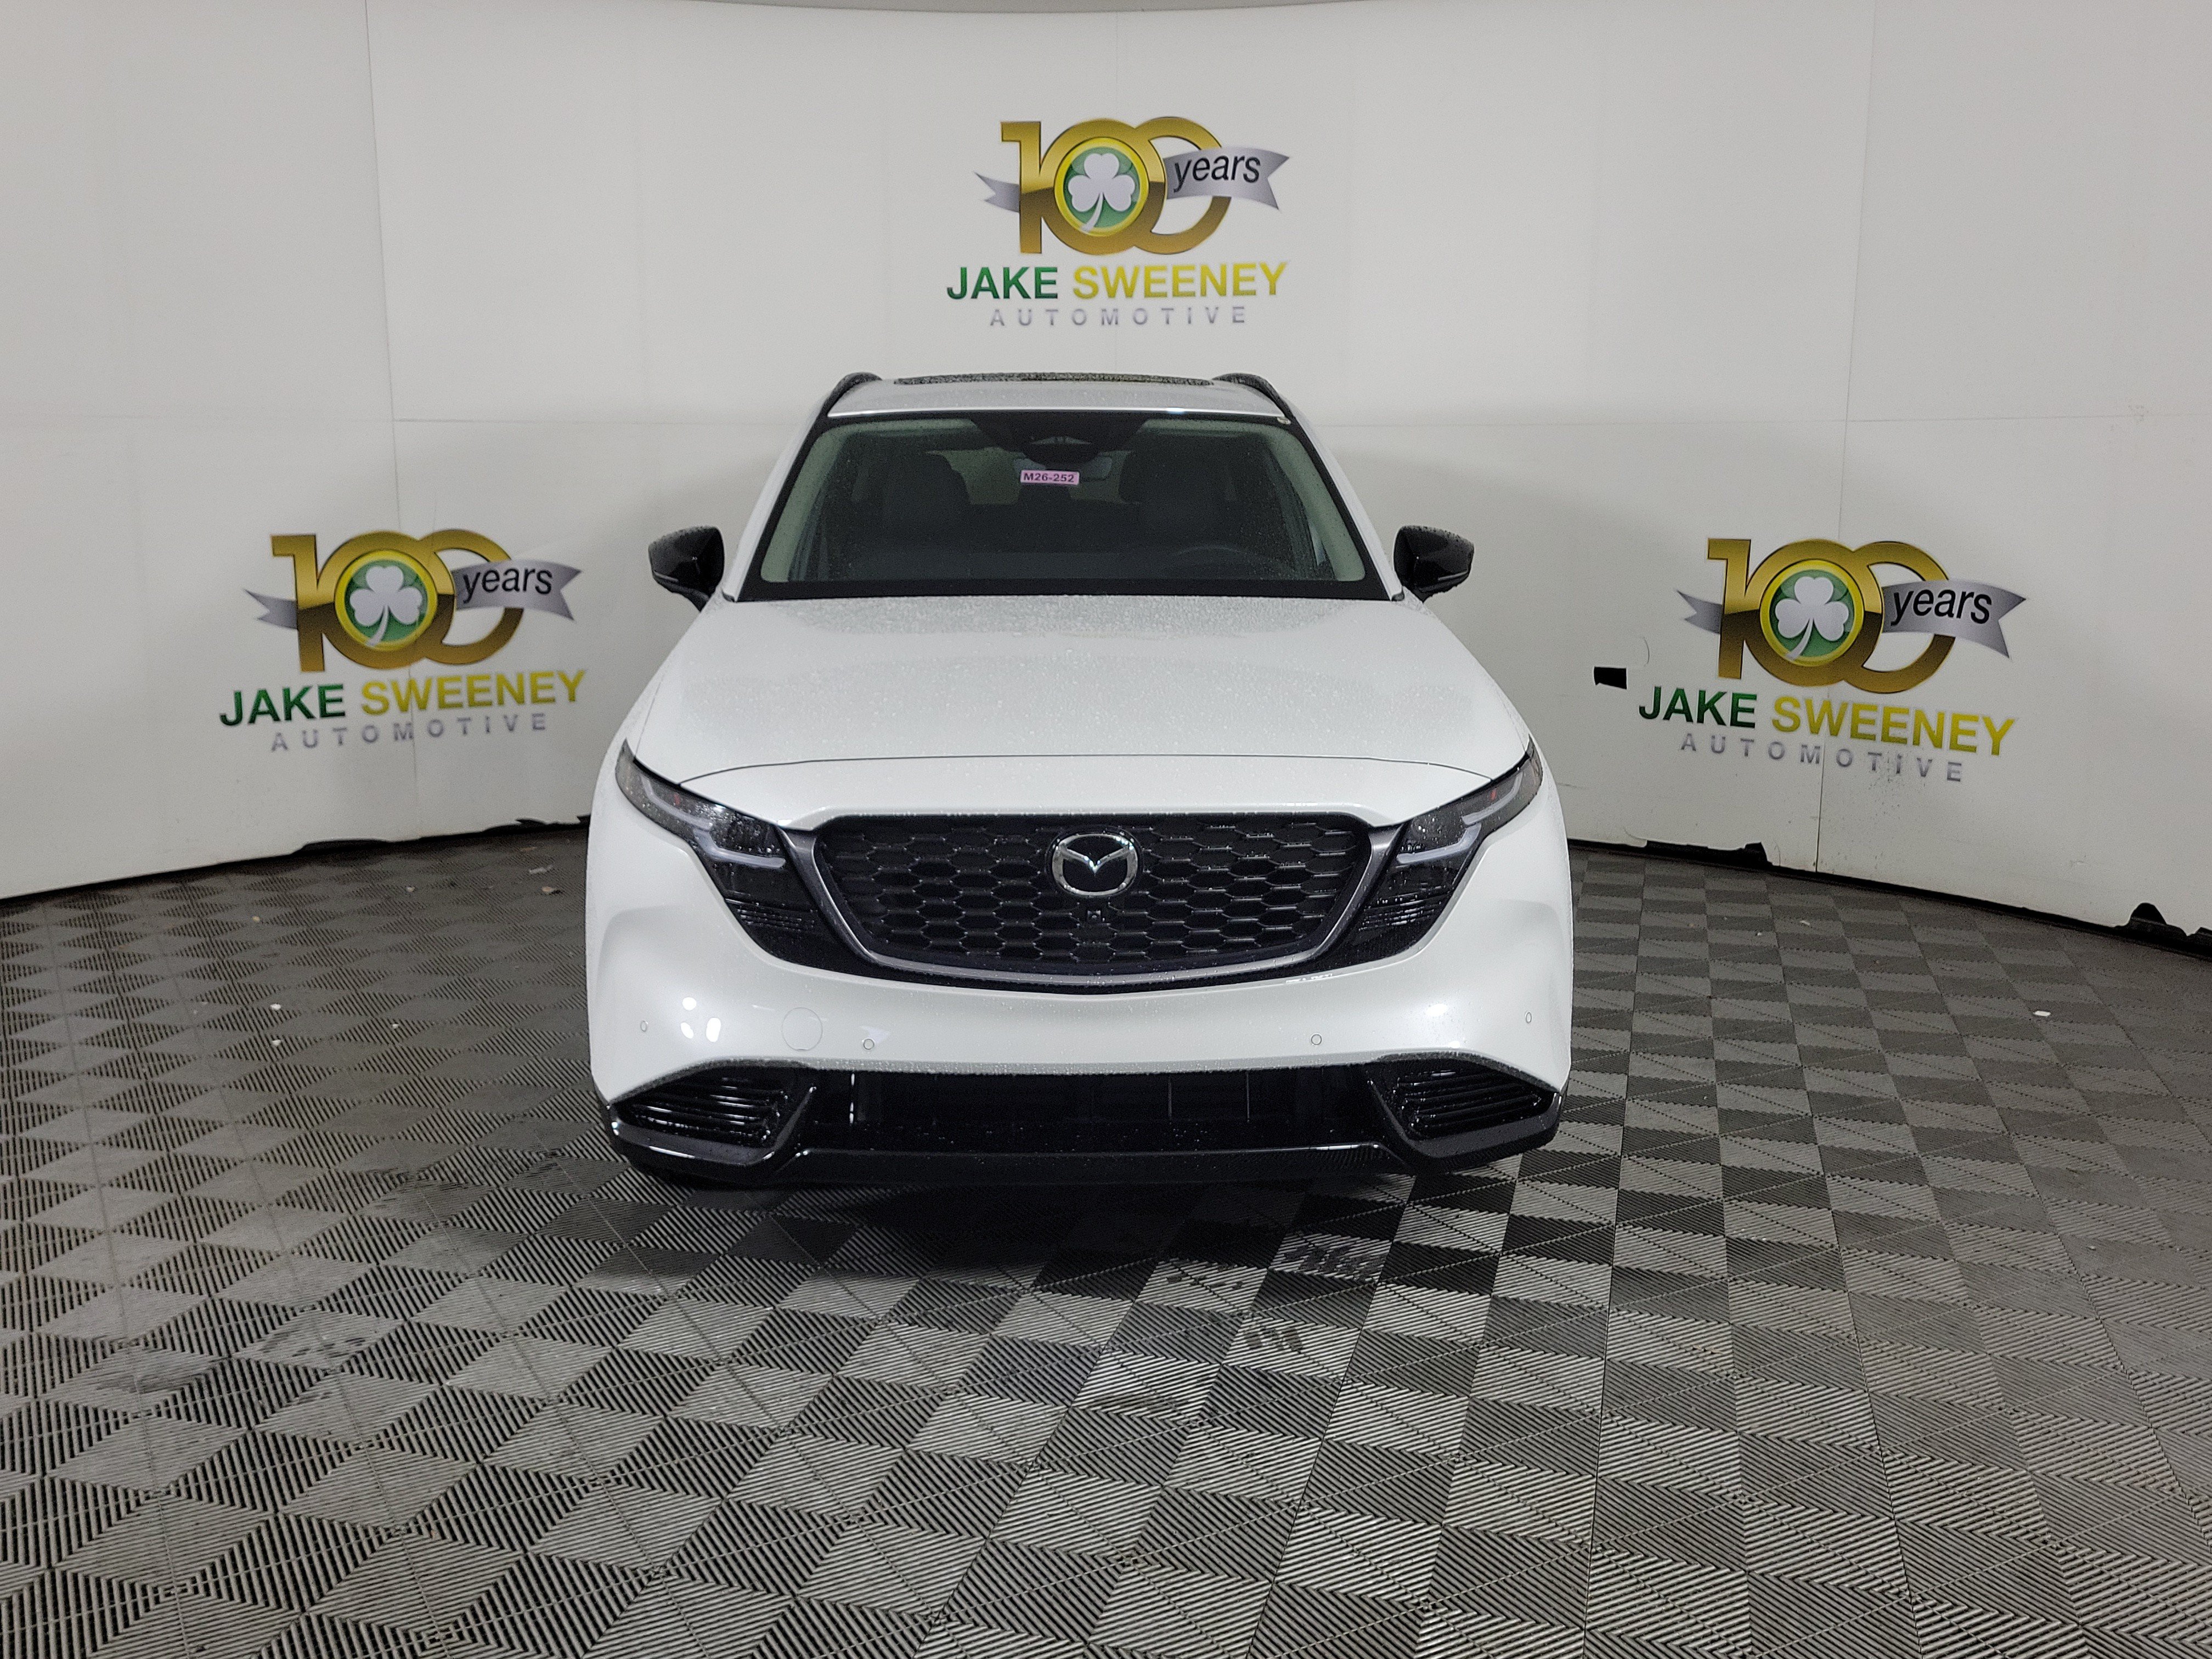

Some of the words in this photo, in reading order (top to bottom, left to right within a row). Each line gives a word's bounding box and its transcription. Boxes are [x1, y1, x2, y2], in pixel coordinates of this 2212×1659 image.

[1001, 116, 1231, 255] 100
[1173, 155, 1261, 193] years
[947, 267, 1058, 300] JAKE
[1073, 262, 1288, 300] SWEENEY
[990, 306, 1246, 326] AUTOMOTIVE
[1023, 472, 1074, 483] M26-252
[271, 529, 524, 672] 100
[462, 568, 553, 604] years
[1707, 538, 1956, 695] 100
[1891, 589, 1992, 625] years
[220, 684, 346, 727] JAKE
[360, 670, 586, 716] SWEENEY
[1639, 686, 1757, 729] JAKE
[1771, 696, 2015, 756] SWEENEY
[271, 713, 546, 752] AUTOMOTIVE
[1680, 733, 1962, 782] AUTOMOTIVE
